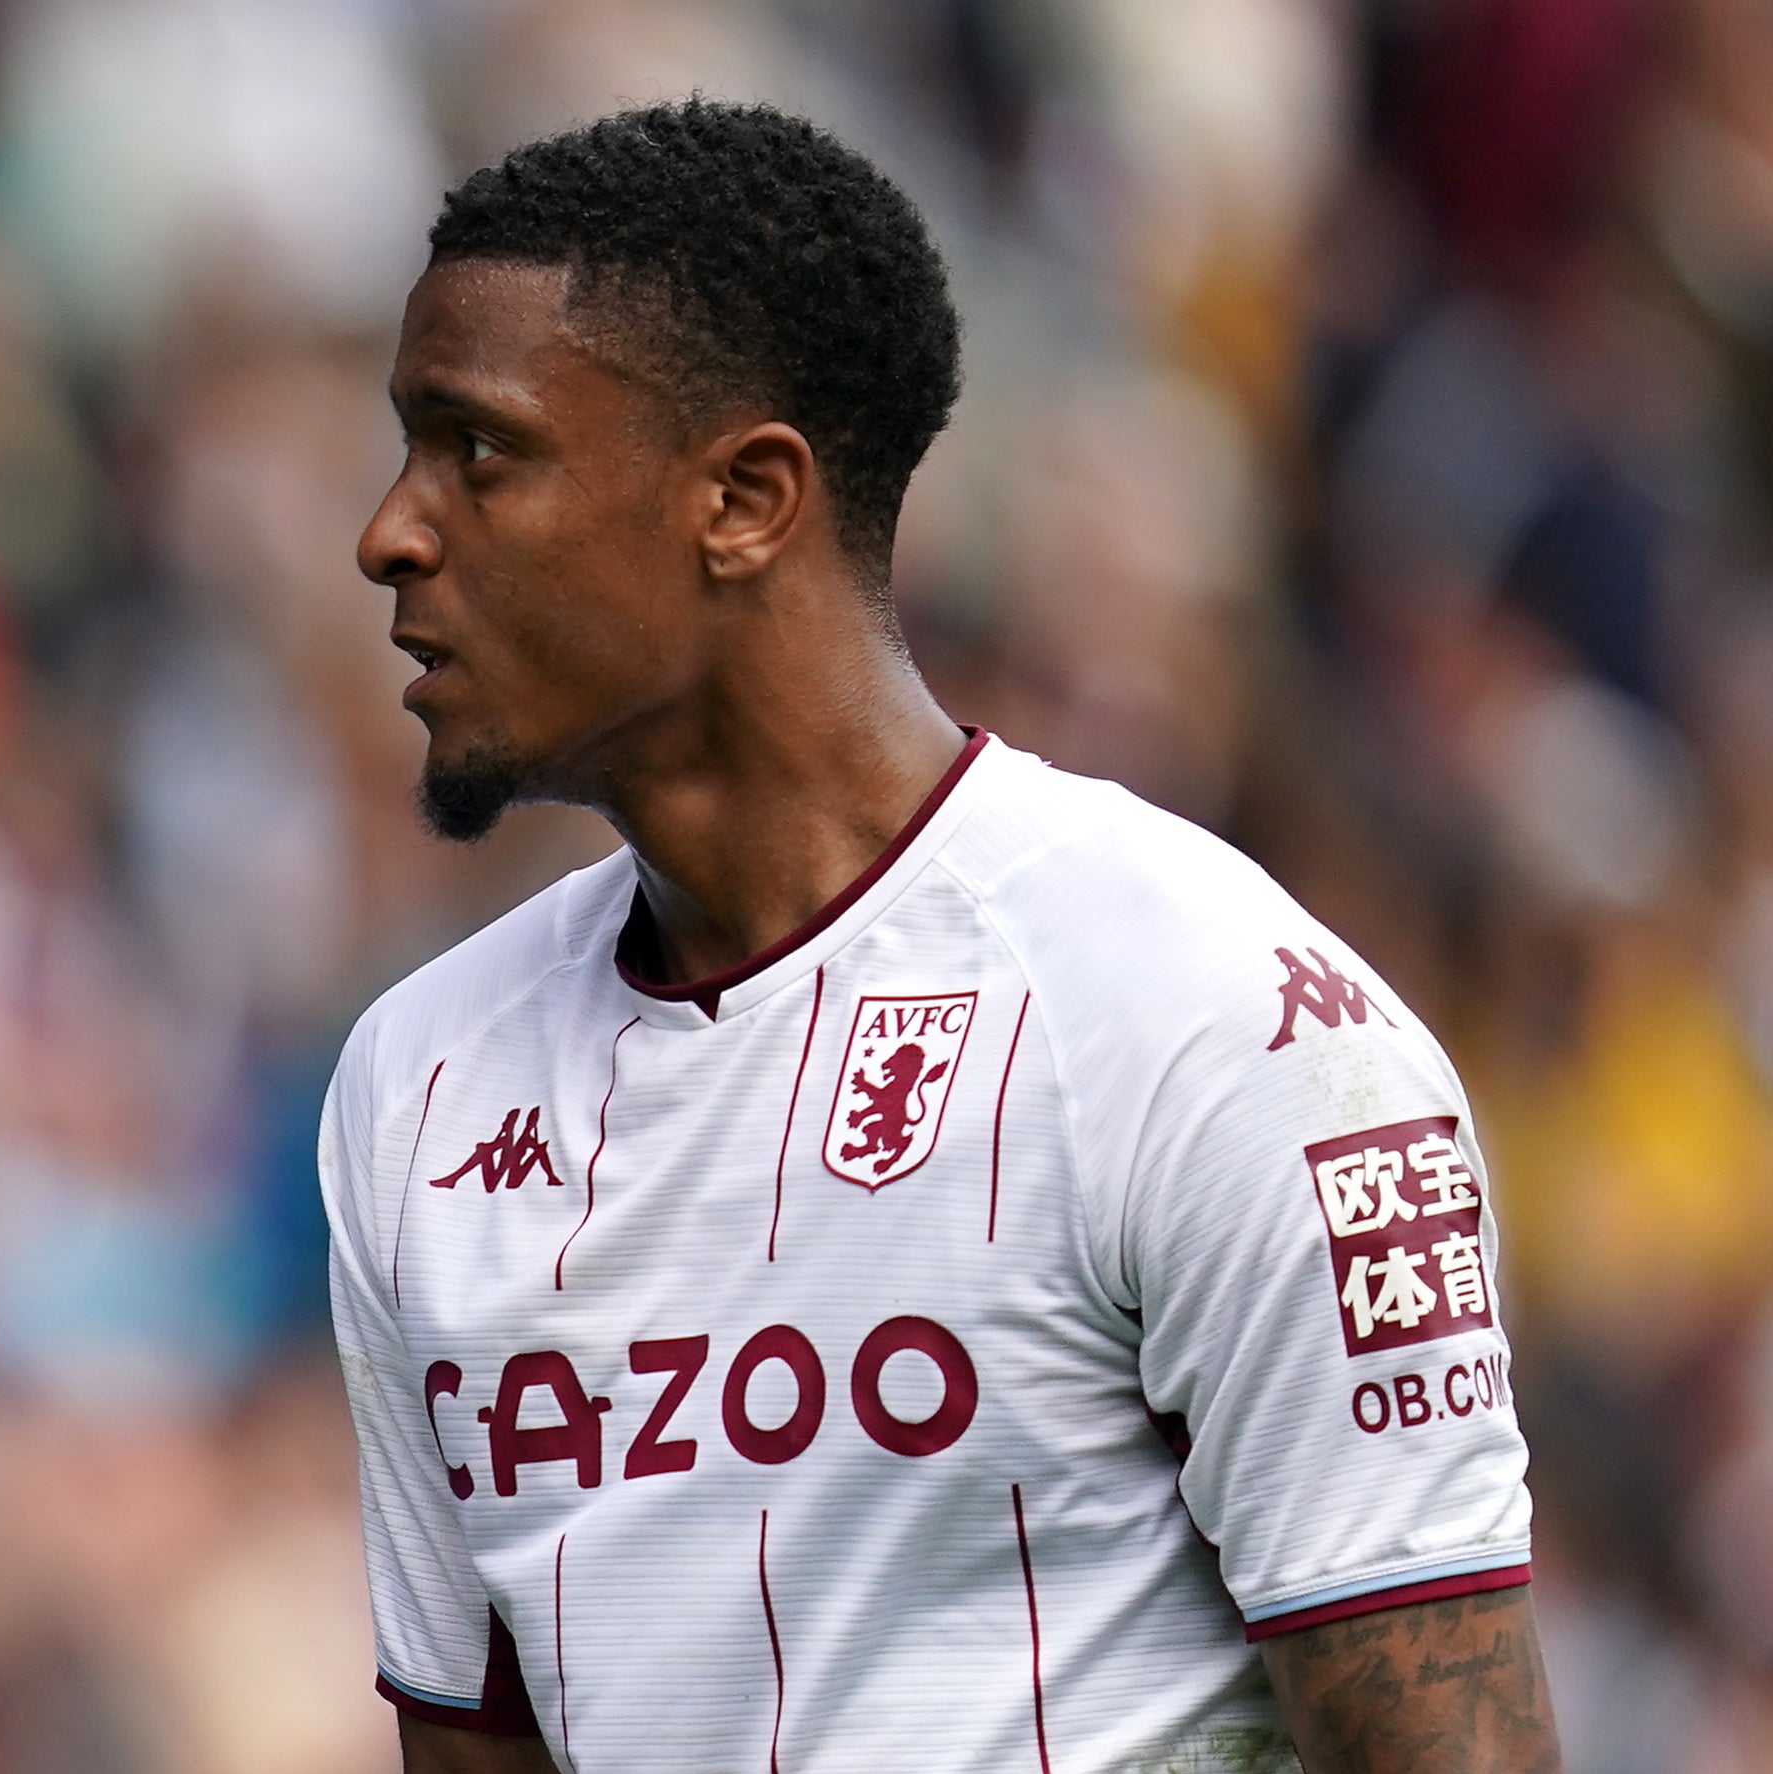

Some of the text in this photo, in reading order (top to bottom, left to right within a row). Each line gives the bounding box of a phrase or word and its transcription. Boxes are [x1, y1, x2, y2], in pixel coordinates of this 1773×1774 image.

[861, 1003, 968, 1038] AVFC
[1316, 1133, 1480, 1238] 欧宝
[1341, 1231, 1487, 1339] 体育
[424, 1315, 979, 1500] CAZOO
